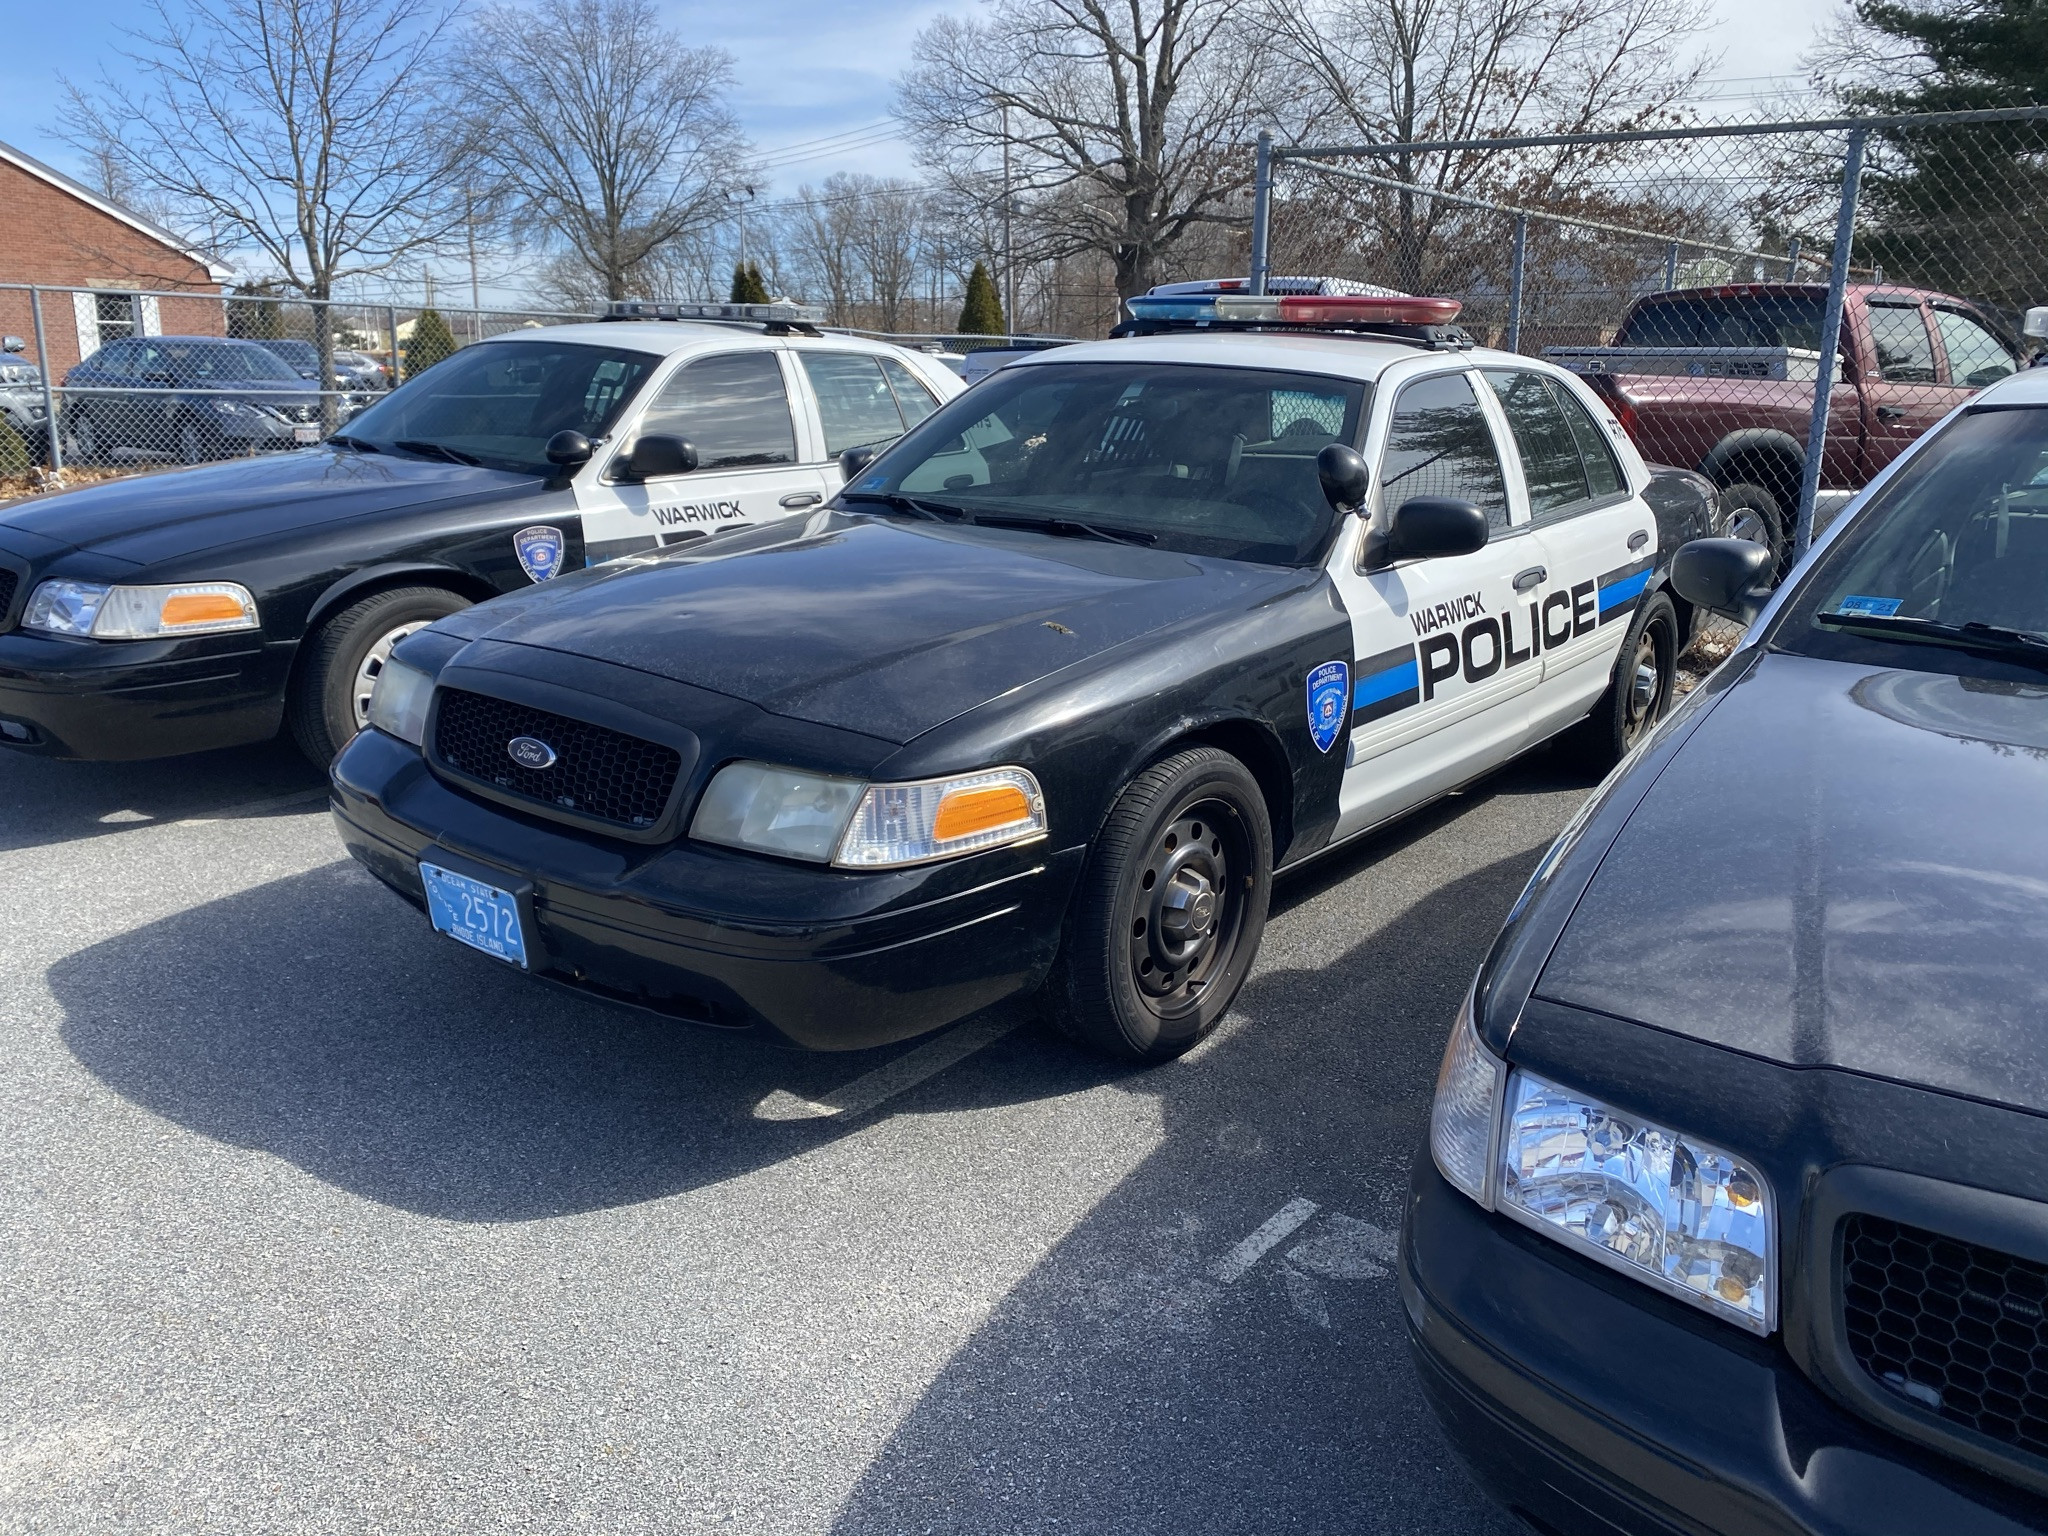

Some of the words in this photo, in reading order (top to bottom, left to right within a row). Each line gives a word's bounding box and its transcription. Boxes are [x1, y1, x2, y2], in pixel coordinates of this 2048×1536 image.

[652, 501, 746, 525] WARWICK
[520, 534, 557, 544] DEPARTMENT
[1409, 591, 1486, 636] WARWICK
[1846, 601, 1862, 609] 08
[1876, 604, 1894, 612] 21
[1419, 579, 1597, 702] POLICE
[1312, 673, 1343, 691] DEPARTMENT
[1318, 665, 1337, 678] POLICE
[1309, 711, 1317, 730] CITY
[1313, 731, 1321, 741] OF
[516, 742, 542, 762] Ford
[428, 880, 459, 922] POLICE
[441, 873, 466, 890] OCEAN
[470, 885, 495, 901] STATE
[461, 892, 518, 945] 2572
[452, 923, 475, 943] RHODE
[476, 933, 504, 953] ISLAND
